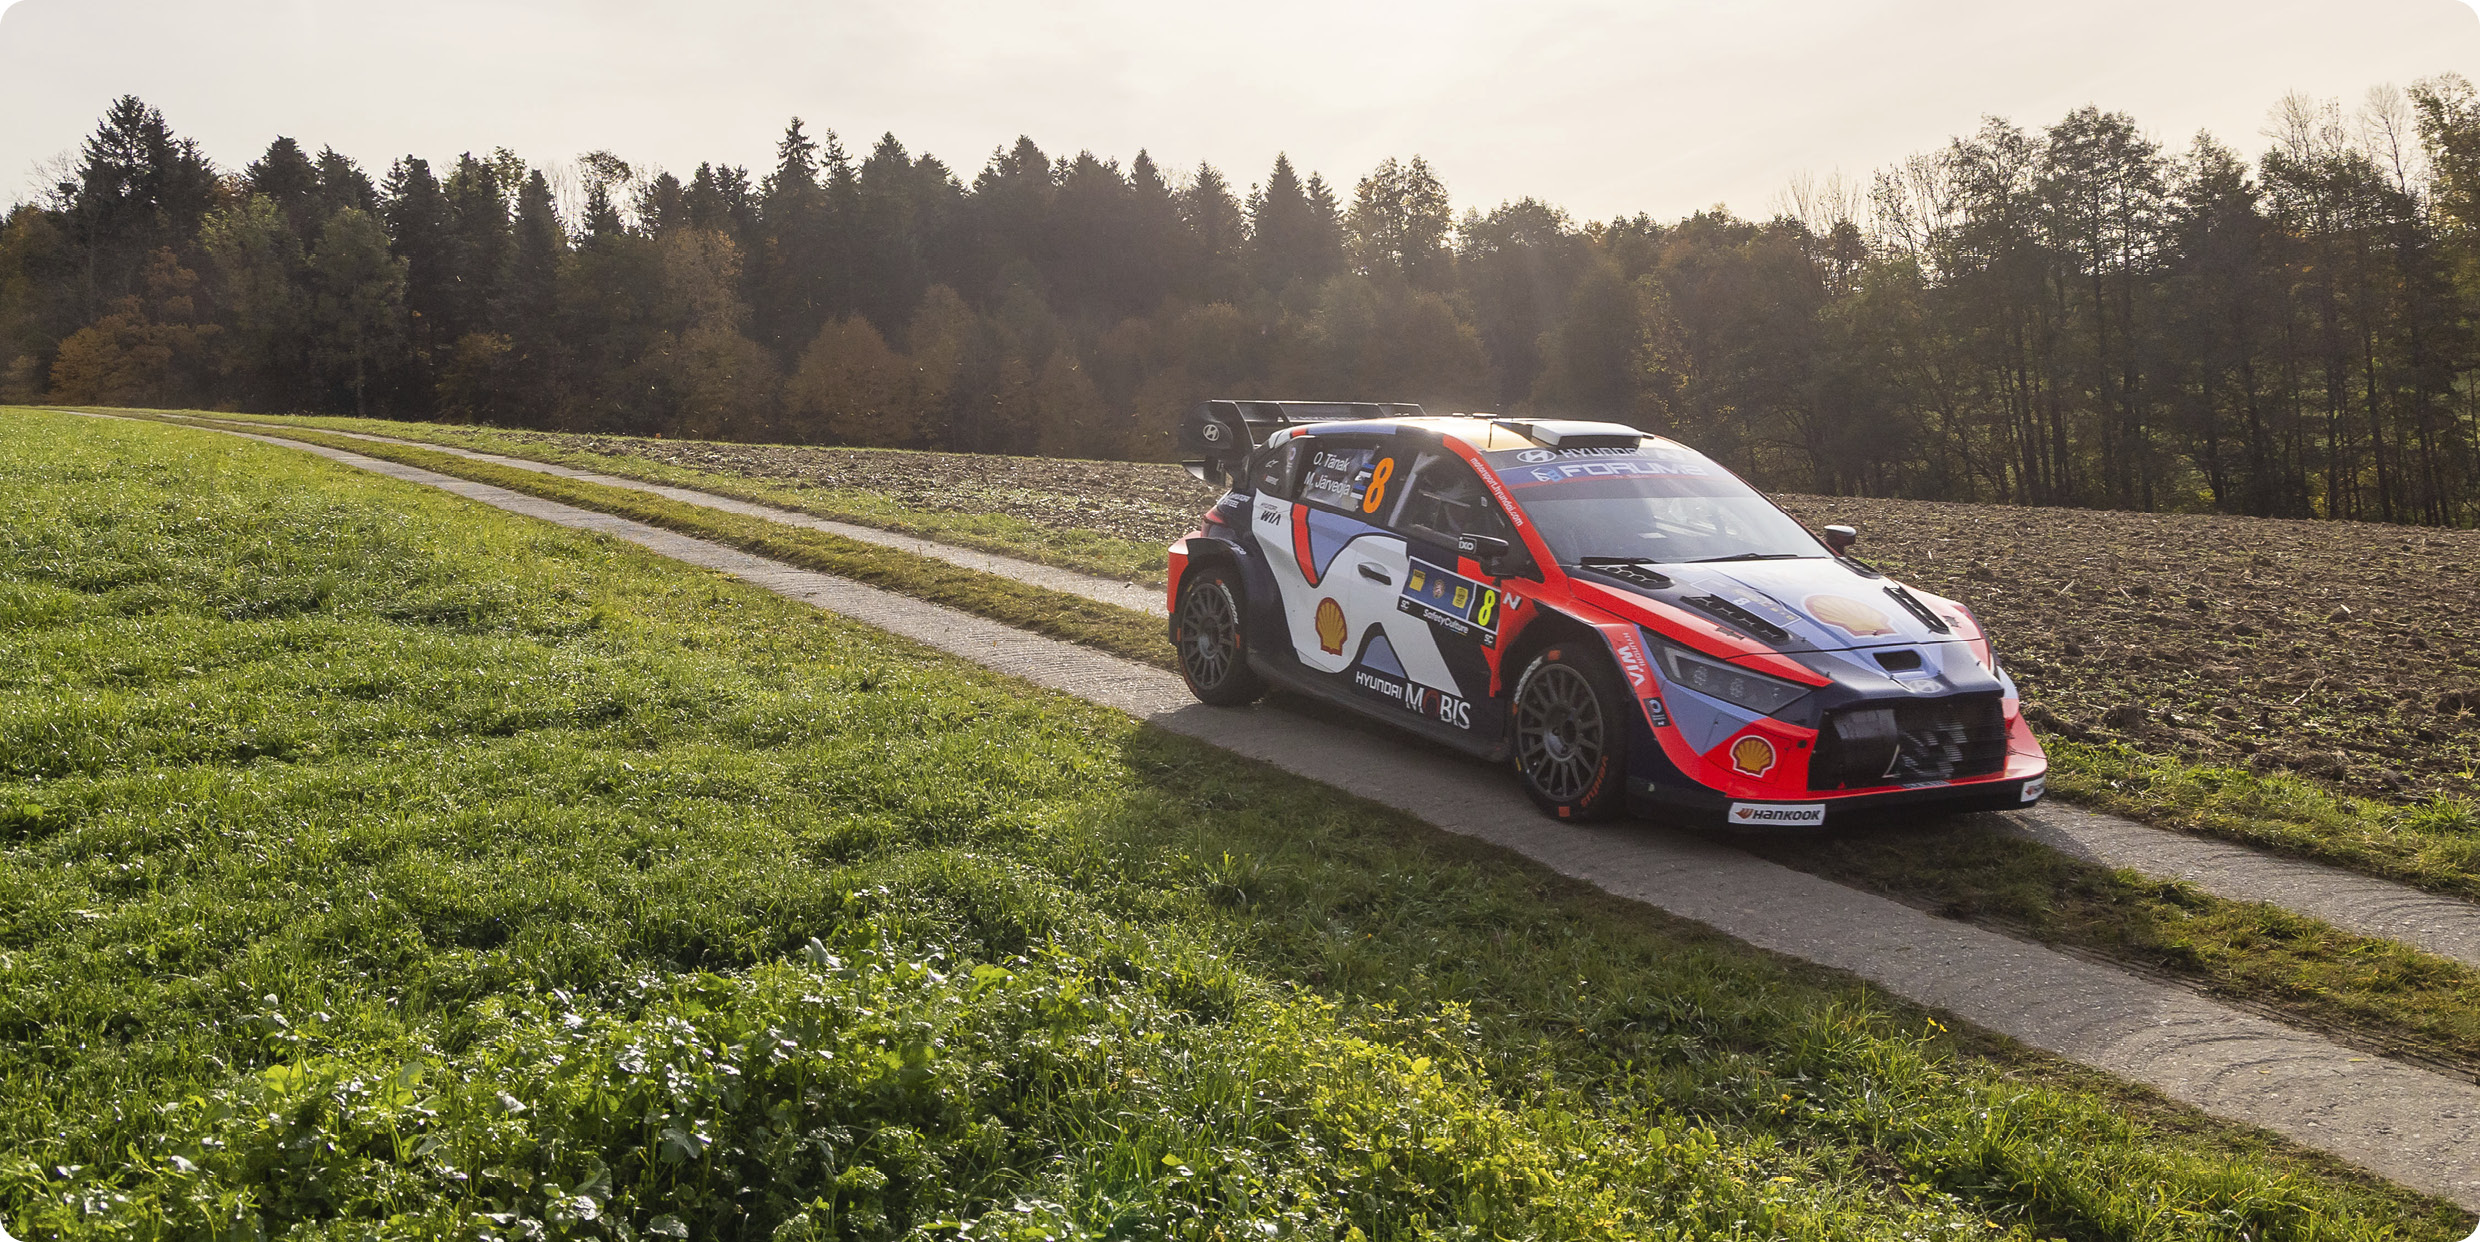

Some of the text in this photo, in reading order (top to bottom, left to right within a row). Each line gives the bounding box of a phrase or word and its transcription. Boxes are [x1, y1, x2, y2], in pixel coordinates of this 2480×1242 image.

[1313, 451, 1324, 466] O.
[1559, 447, 1648, 459] HYUNDAI
[1363, 457, 1394, 514] 8
[1470, 457, 1524, 527] motorsport.hyundai.com
[1478, 589, 1496, 627] 8
[1503, 592, 1522, 611] N
[1423, 609, 1469, 635] SafetyCulture
[1617, 645, 1646, 687] WIA
[1355, 671, 1471, 730] HYUNDAI MOBIS
